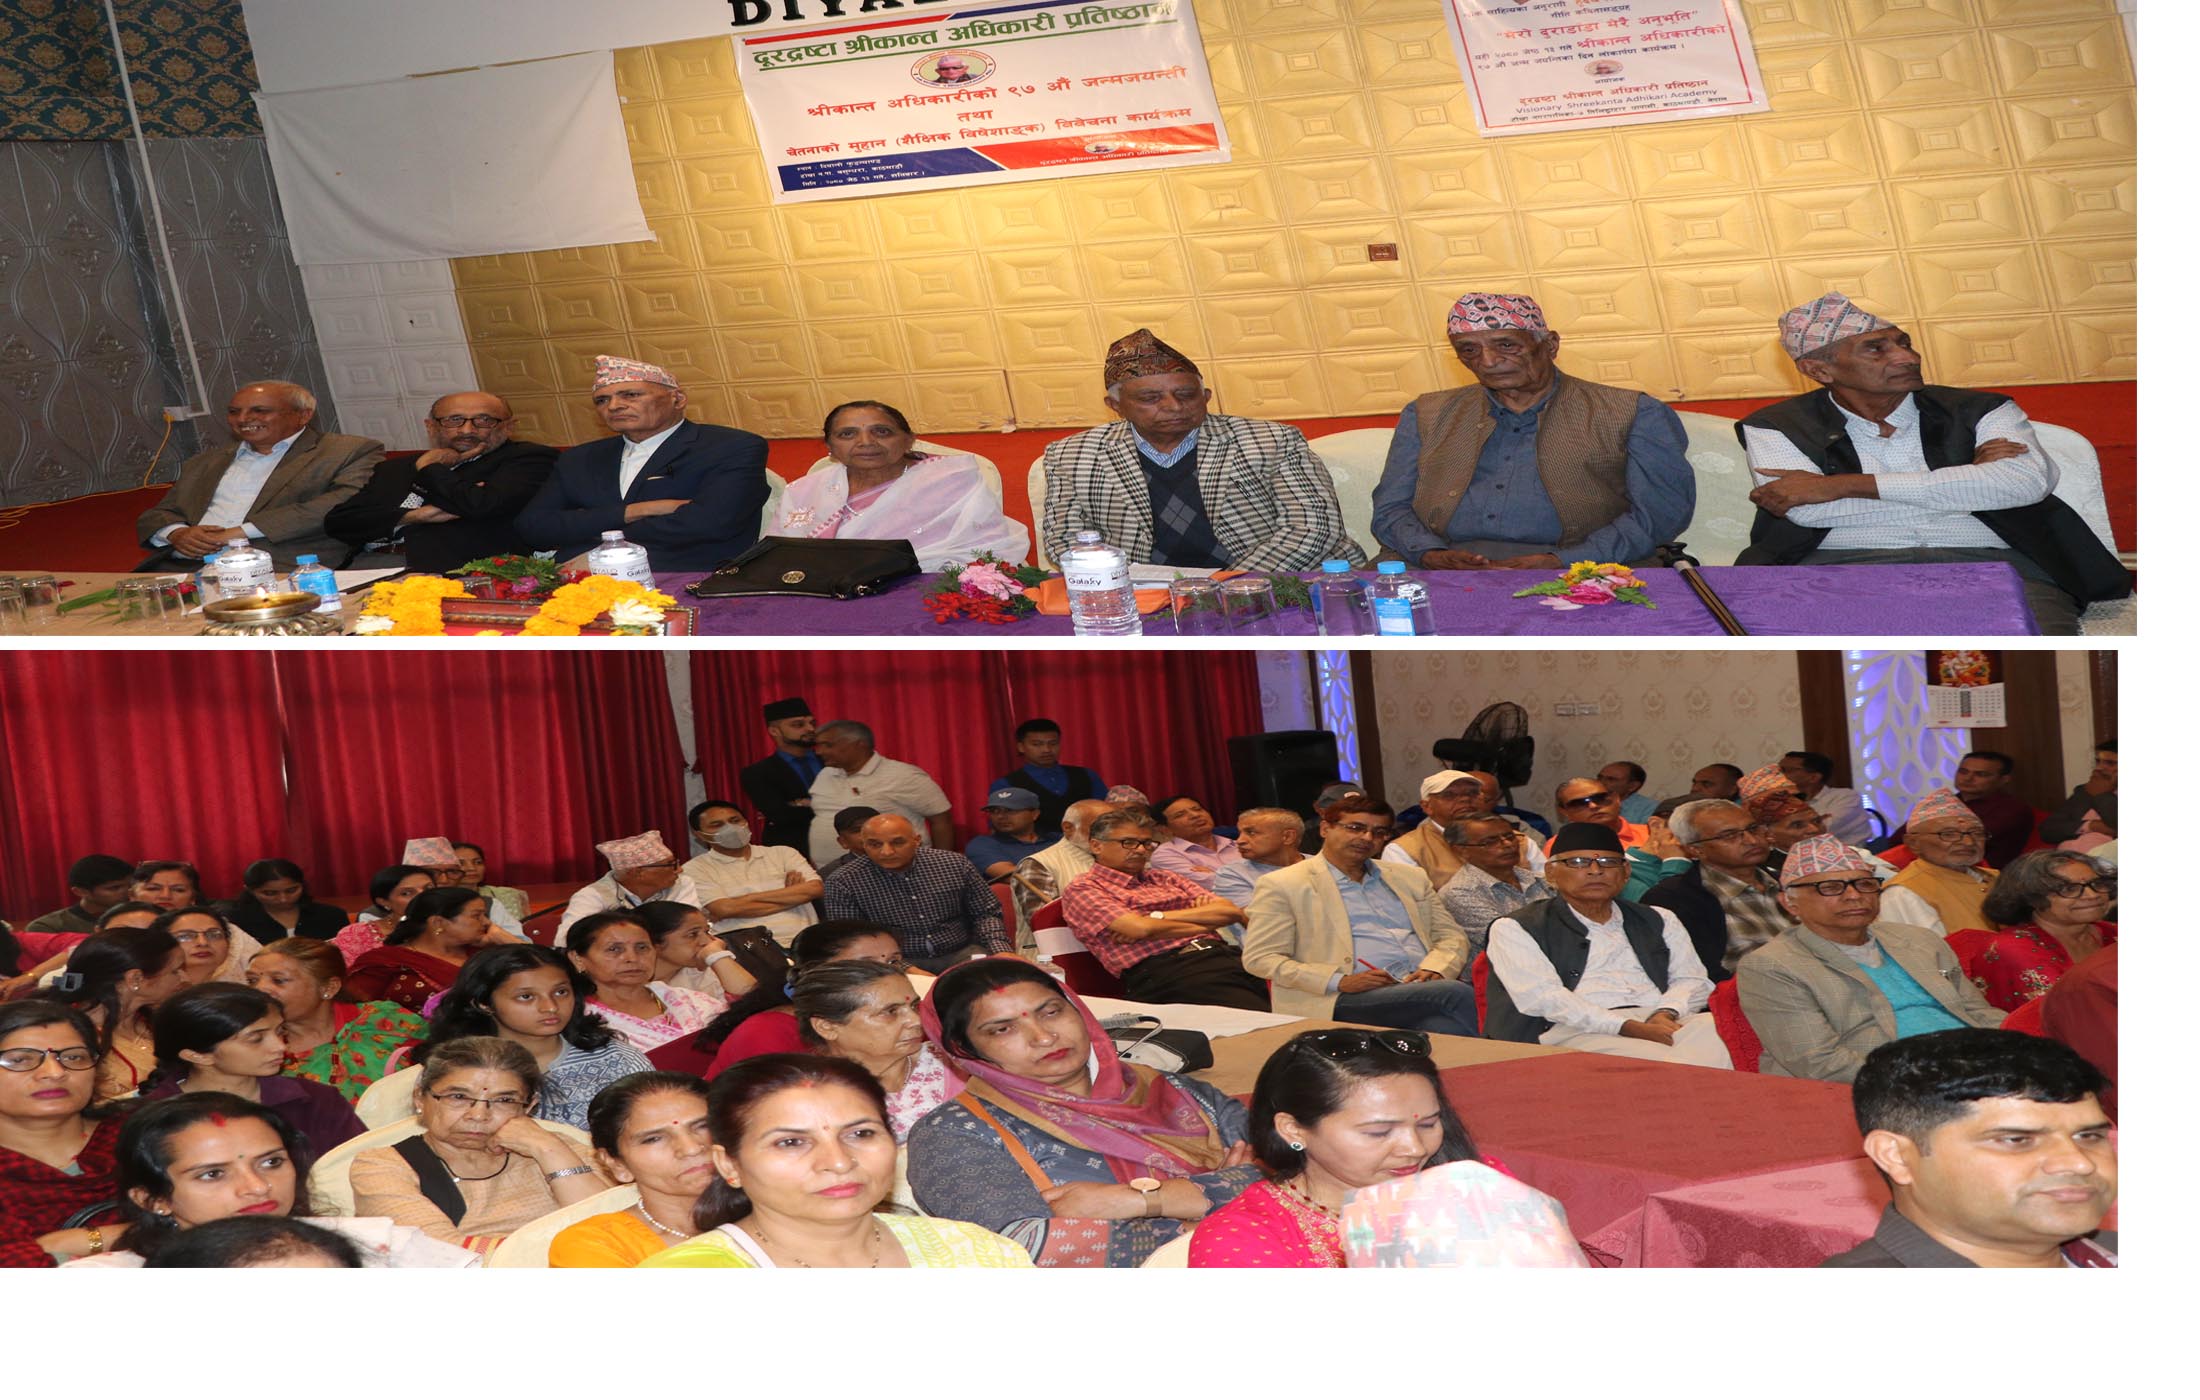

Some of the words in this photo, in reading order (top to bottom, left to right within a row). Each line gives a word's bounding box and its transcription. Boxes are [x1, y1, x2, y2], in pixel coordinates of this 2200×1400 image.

[752, 42, 837, 67] दूरद्रष्टा
[844, 29, 938, 54] श्रीकान्त
[946, 12, 1056, 41] अधिकारी
[1577, 35, 1632, 49] श्रीकान्त
[1640, 25, 1727, 42] अधिकारीको
[807, 101, 877, 117] श्रीकान्त
[888, 86, 997, 108] अधिकारीको
[1008, 85, 1036, 98] ९७
[1081, 65, 1187, 87] जन्मजयन्ती
[1515, 105, 1562, 114] Visionary
[1567, 98, 1623, 109] Shreekanta
[1626, 93, 1667, 103] Adhikari
[1671, 89, 1717, 99] Academy
[786, 142, 840, 157] चेतनाको
[848, 138, 886, 153] मुहान
[1055, 115, 1118, 130] विवेचना
[1126, 108, 1192, 122] कार्यक्रम
[957, 109, 993, 121] तथा
